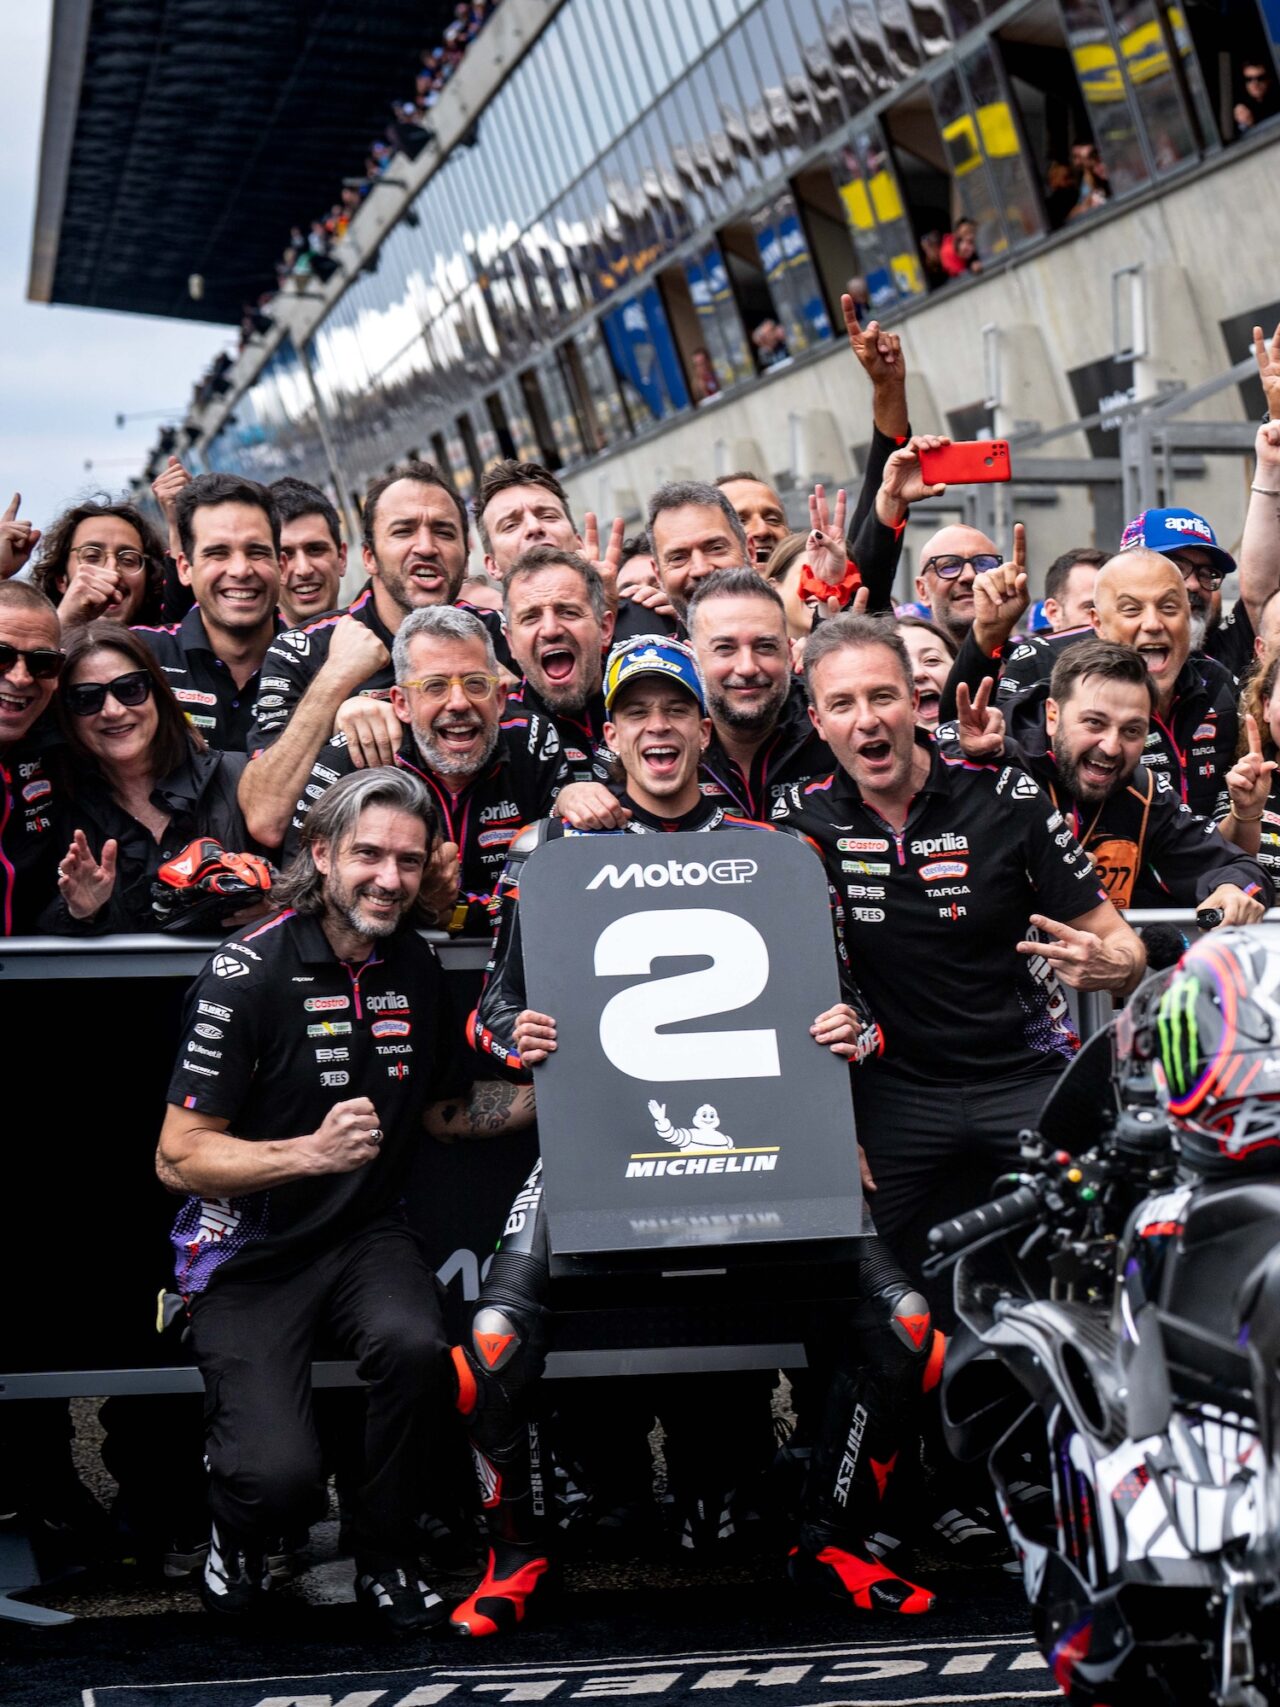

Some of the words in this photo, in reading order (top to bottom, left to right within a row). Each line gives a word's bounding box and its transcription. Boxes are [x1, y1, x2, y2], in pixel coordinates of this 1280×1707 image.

[1165, 516, 1211, 537] aprilia
[619, 659, 682, 678] MICHELIN
[178, 691, 215, 704] Castrol
[1192, 748, 1216, 756] TARGA
[848, 839, 886, 851] Castrol
[911, 832, 968, 857] aprilia
[586, 859, 758, 890] MotoGP
[921, 863, 964, 879] sterilgarda
[847, 885, 886, 897] BS
[925, 886, 971, 897] TARGA
[366, 991, 409, 1011] aprilia
[593, 908, 781, 1082] 2
[314, 999, 347, 1009] Castrol
[315, 1048, 350, 1060] BS
[376, 1045, 413, 1055] TARGA
[625, 1154, 778, 1178] MICHELIN
[832, 1402, 869, 1508] DAINESE
